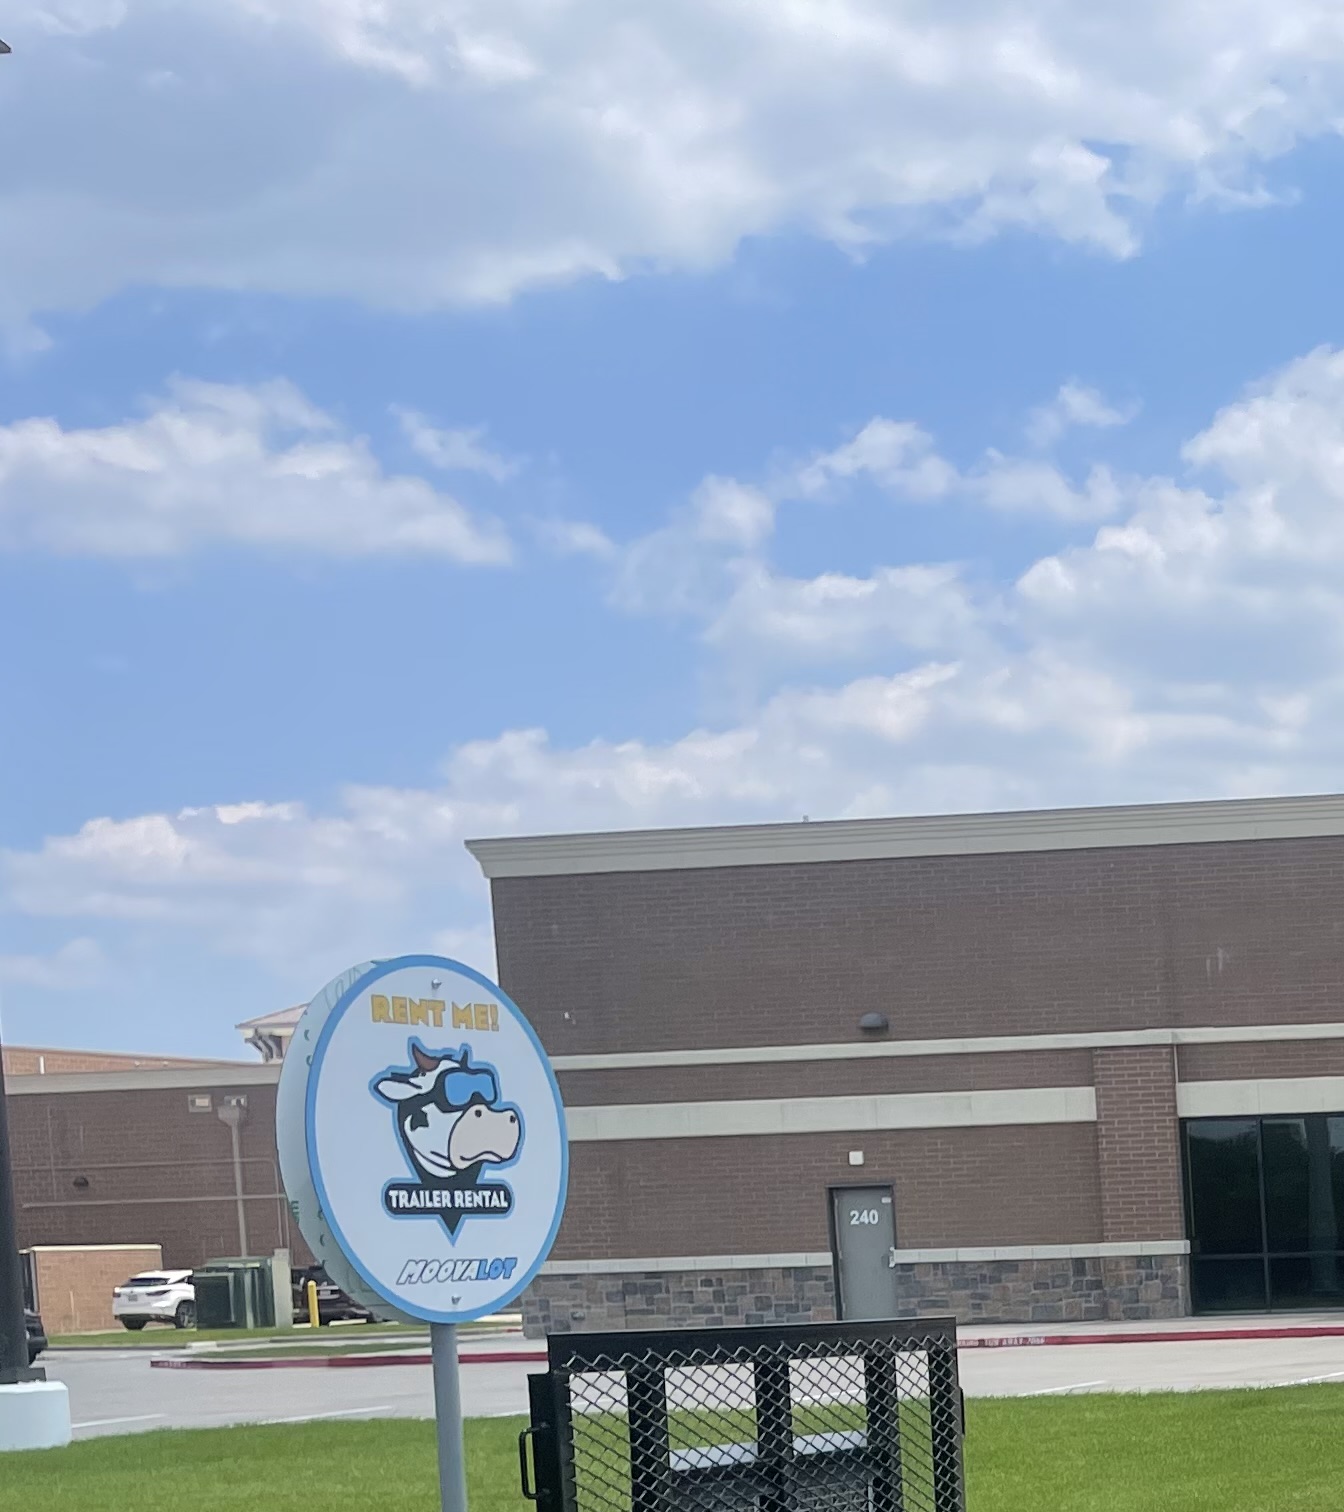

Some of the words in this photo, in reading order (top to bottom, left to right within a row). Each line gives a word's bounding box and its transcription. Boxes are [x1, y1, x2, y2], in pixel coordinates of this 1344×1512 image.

[371, 994, 446, 1028] RENT
[451, 1001, 500, 1032] ME!
[388, 1190, 452, 1208] TRAILER
[453, 1190, 508, 1208] RENTAL
[850, 1209, 879, 1225] 240
[396, 1257, 518, 1285] MOOVALOT
